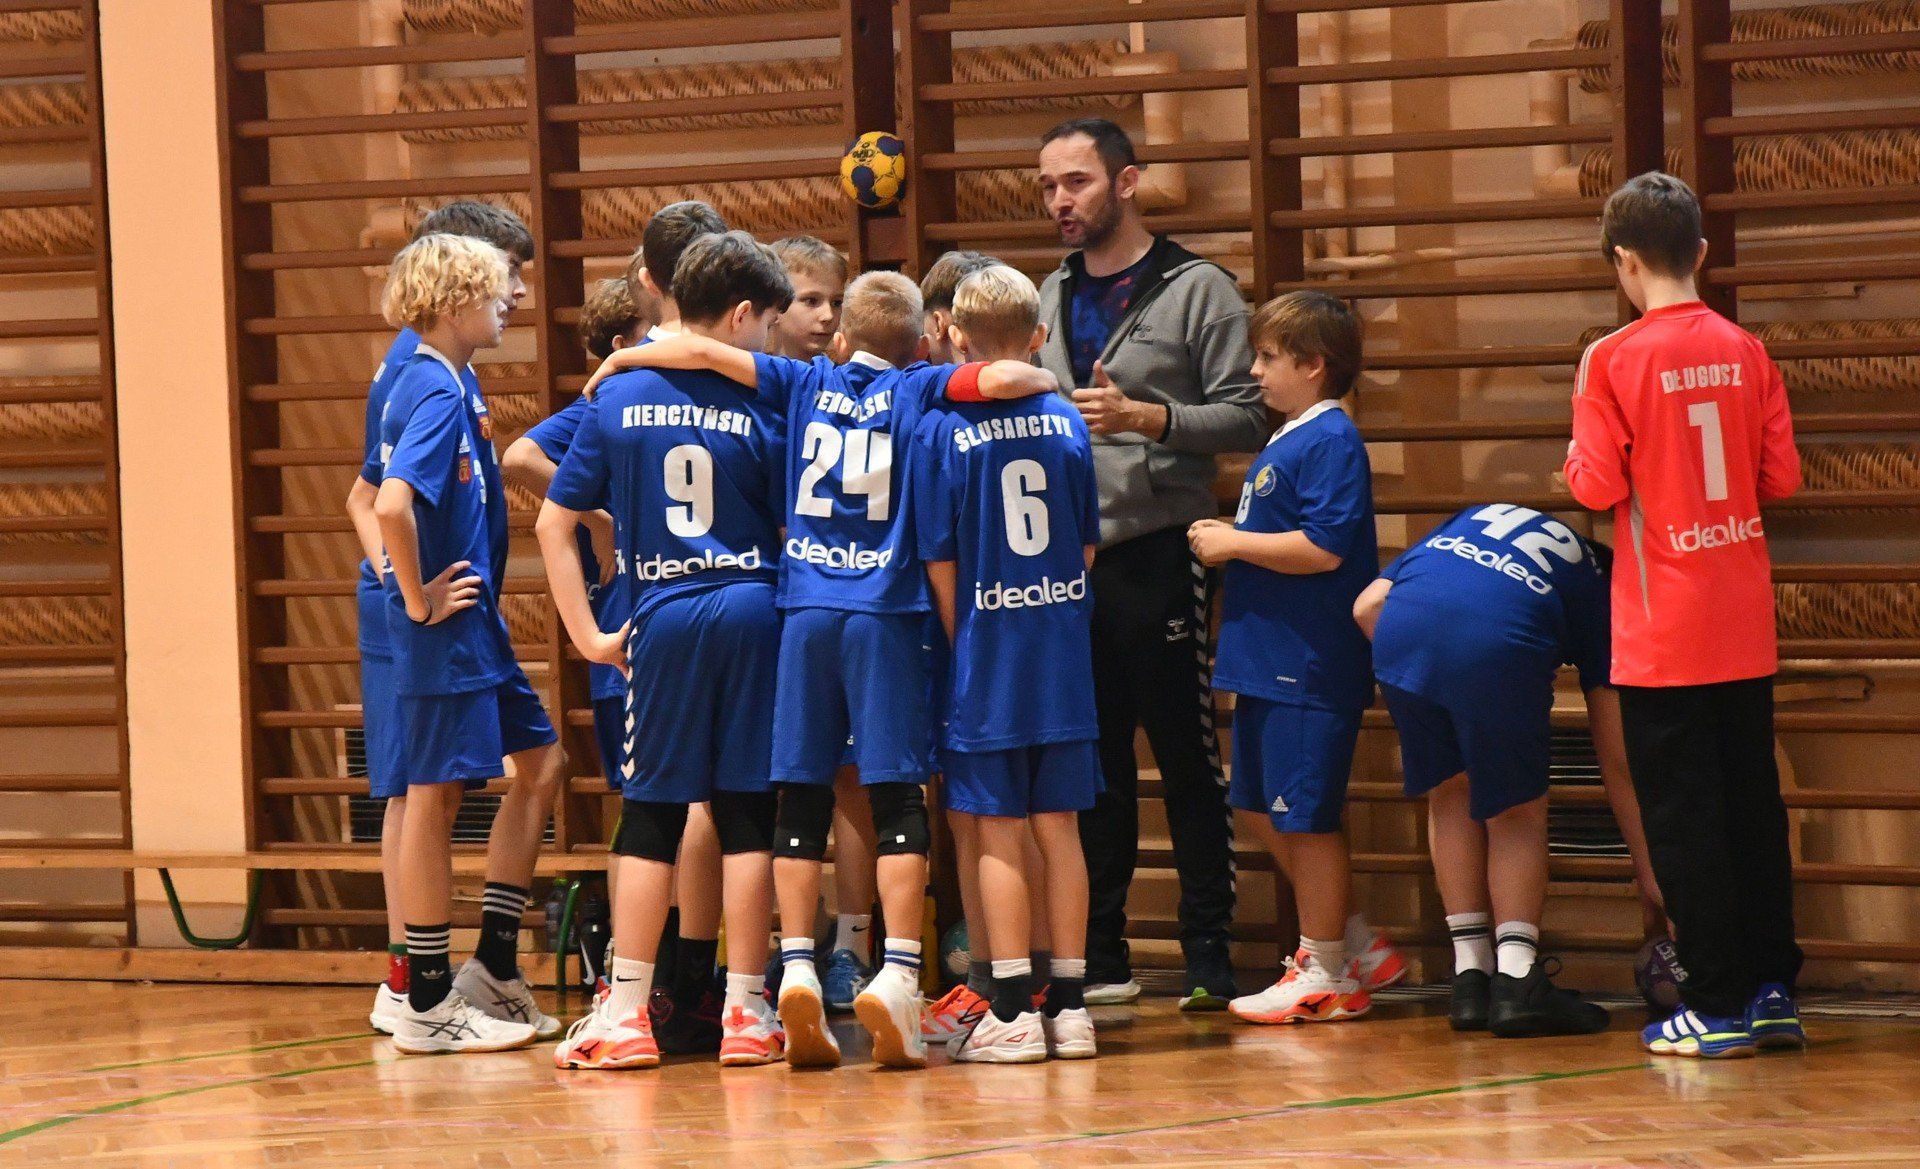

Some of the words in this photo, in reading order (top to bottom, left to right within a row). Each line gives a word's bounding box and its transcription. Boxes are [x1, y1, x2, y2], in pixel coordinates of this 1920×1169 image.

[1660, 363, 1742, 394] DŁUGOSZ
[622, 404, 752, 437] KIERCZYŃSKI
[953, 413, 1074, 453] ŚLUSARCZYK
[794, 421, 893, 522] 24
[1687, 401, 1728, 501] 1
[663, 444, 714, 538] 9
[1001, 458, 1050, 557] 6
[635, 545, 761, 582] idealed
[1470, 503, 1583, 575] 42
[975, 570, 1086, 612] idealed
